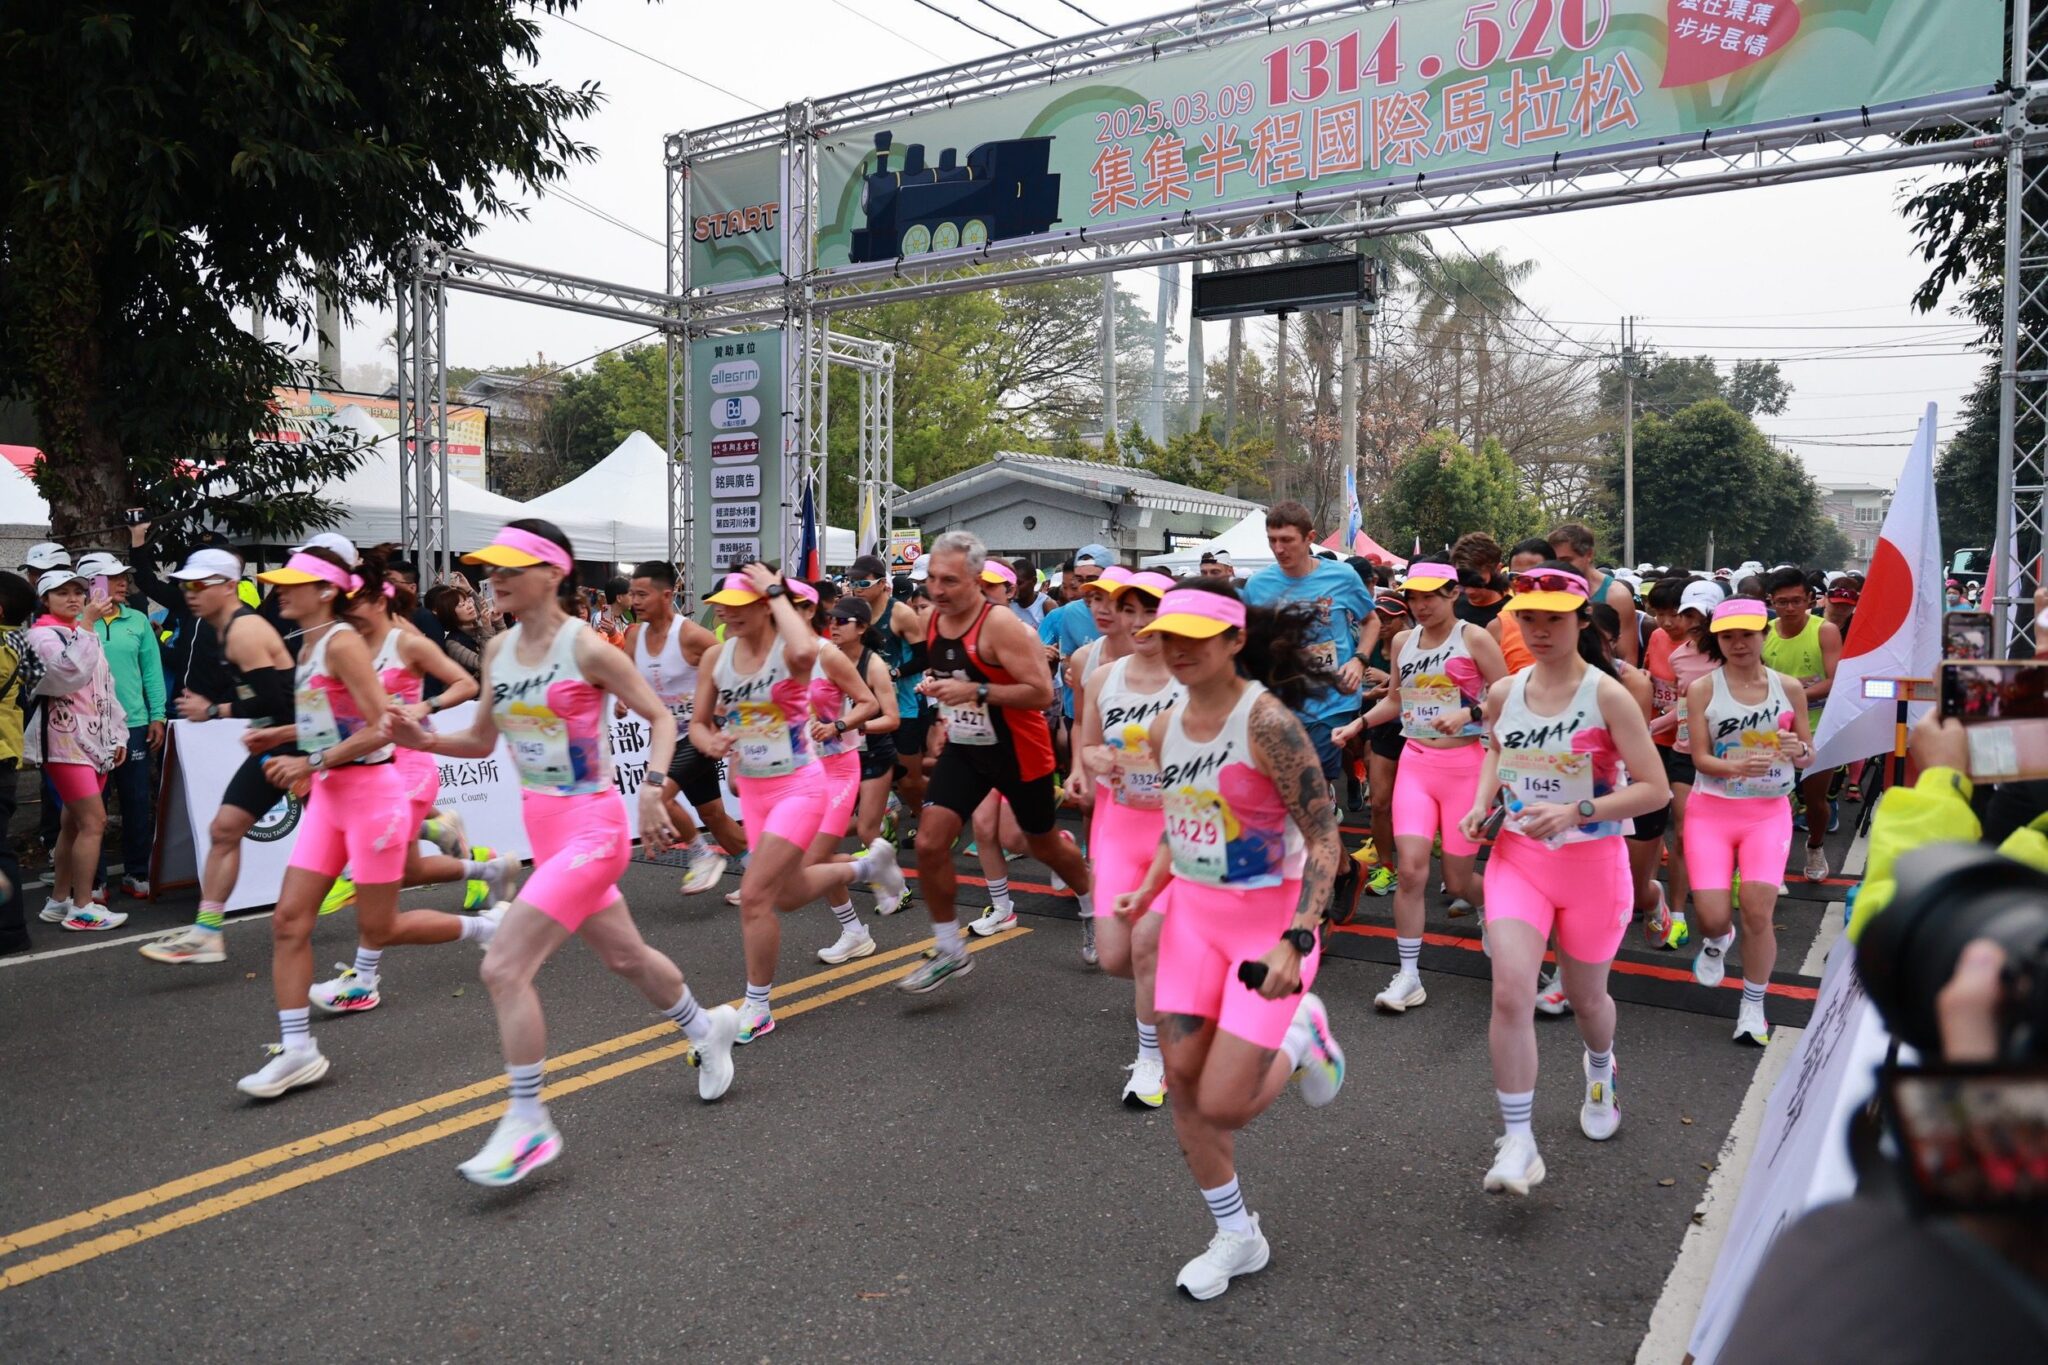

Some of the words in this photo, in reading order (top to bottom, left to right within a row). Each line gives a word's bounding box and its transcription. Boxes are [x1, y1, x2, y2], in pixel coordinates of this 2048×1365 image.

[1095, 81, 1255, 143] 2025.03.09
[1089, 50, 1643, 216] 集集半程國際馬拉松
[693, 202, 780, 242] START
[716, 474, 755, 488] 銘興廣告
[716, 506, 756, 517] 經濟部水利署
[716, 518, 756, 528] 第四河川分署
[954, 710, 984, 726] 1427
[1417, 706, 1440, 716] 1647
[1524, 777, 1561, 792] 1645
[432, 796, 457, 806] antou
[461, 792, 488, 803] County
[1169, 815, 1217, 845] 1429
